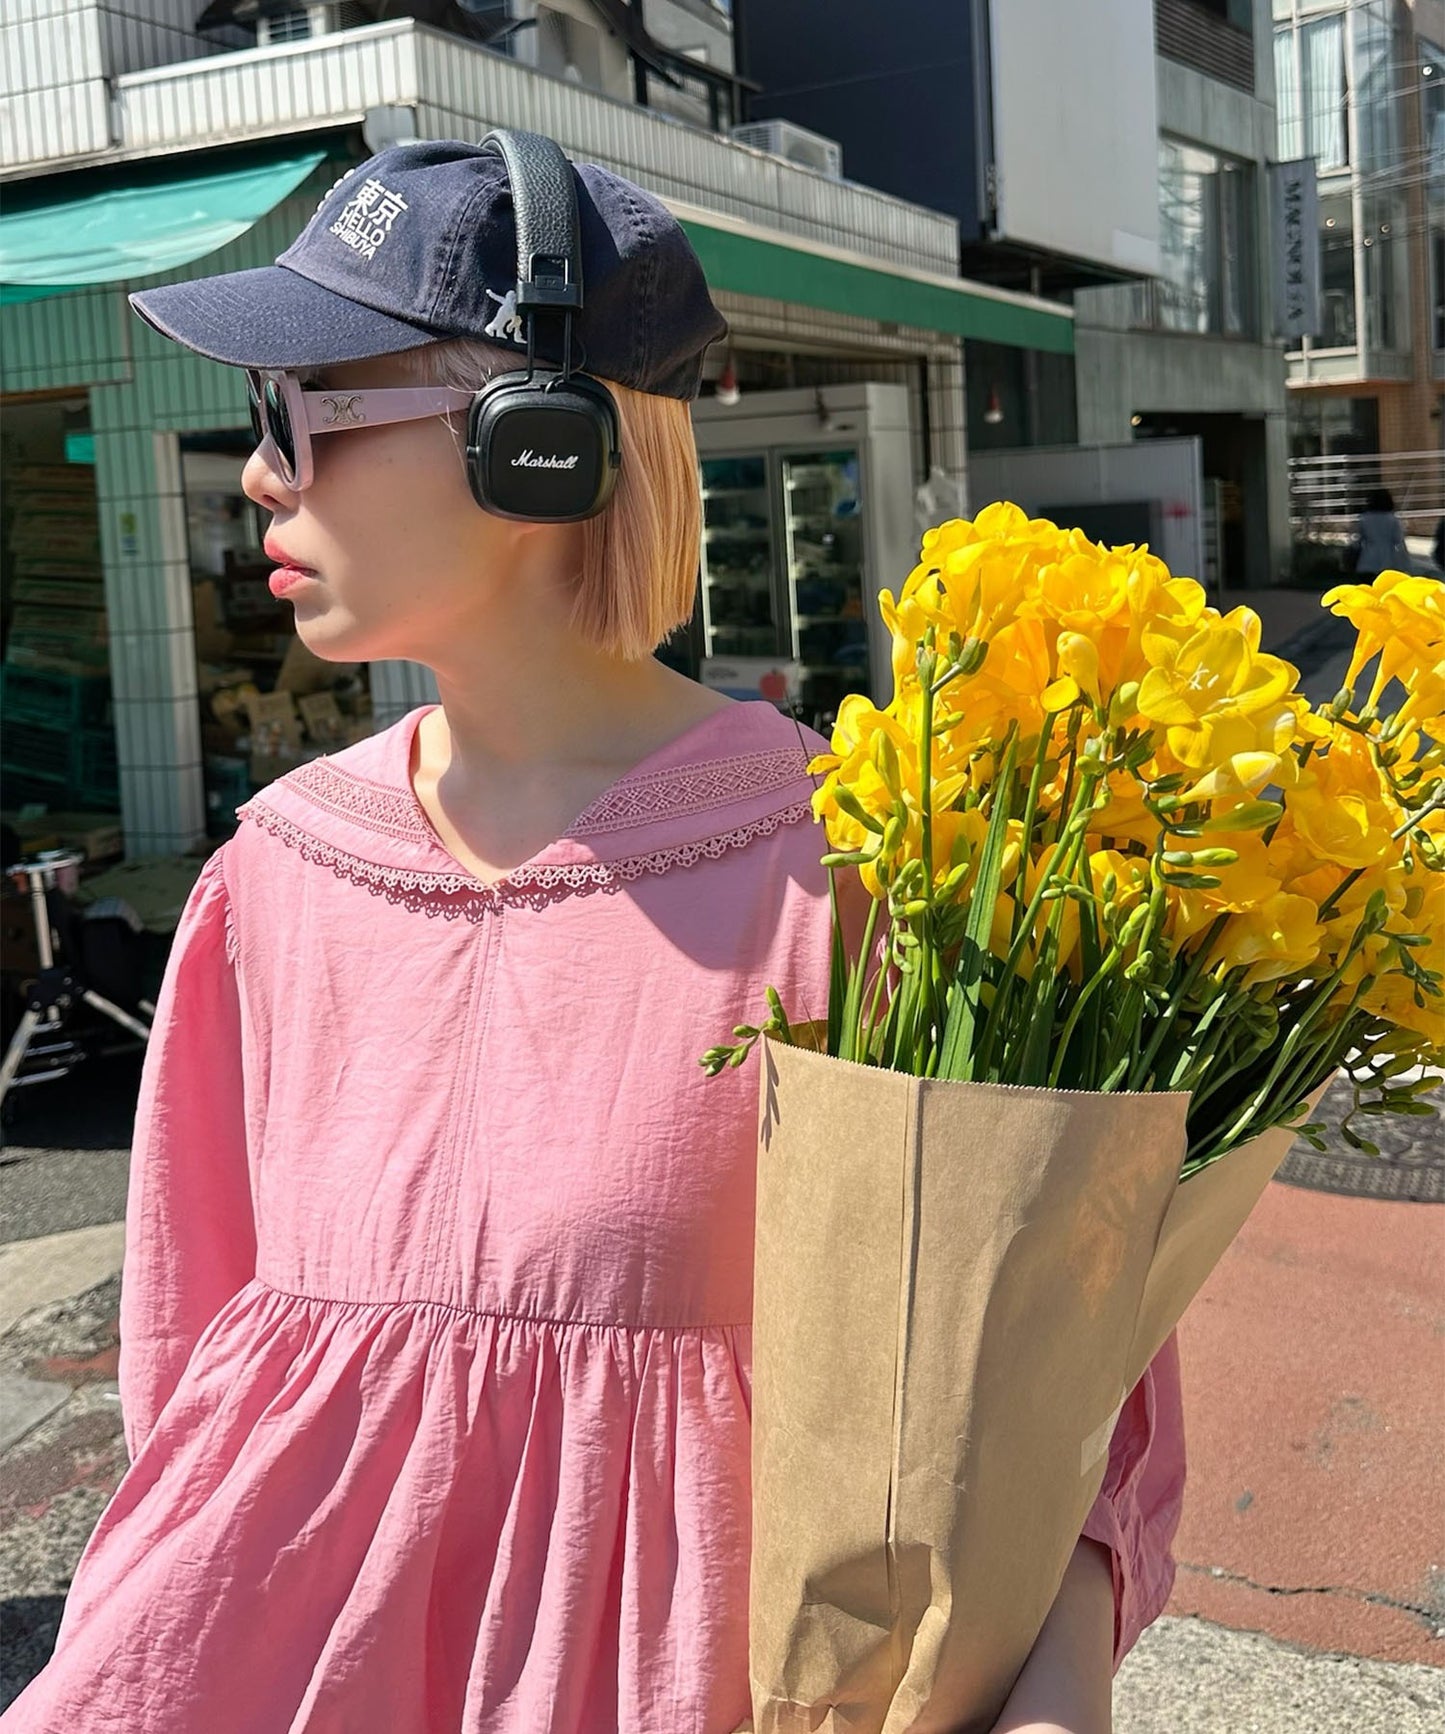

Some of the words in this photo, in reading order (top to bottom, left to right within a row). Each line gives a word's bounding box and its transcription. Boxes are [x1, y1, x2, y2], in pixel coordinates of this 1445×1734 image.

[348, 178, 408, 231] 東京
[329, 222, 377, 260] SHIBUYA
[337, 206, 385, 247] HELLO
[511, 449, 579, 469] Marshall
